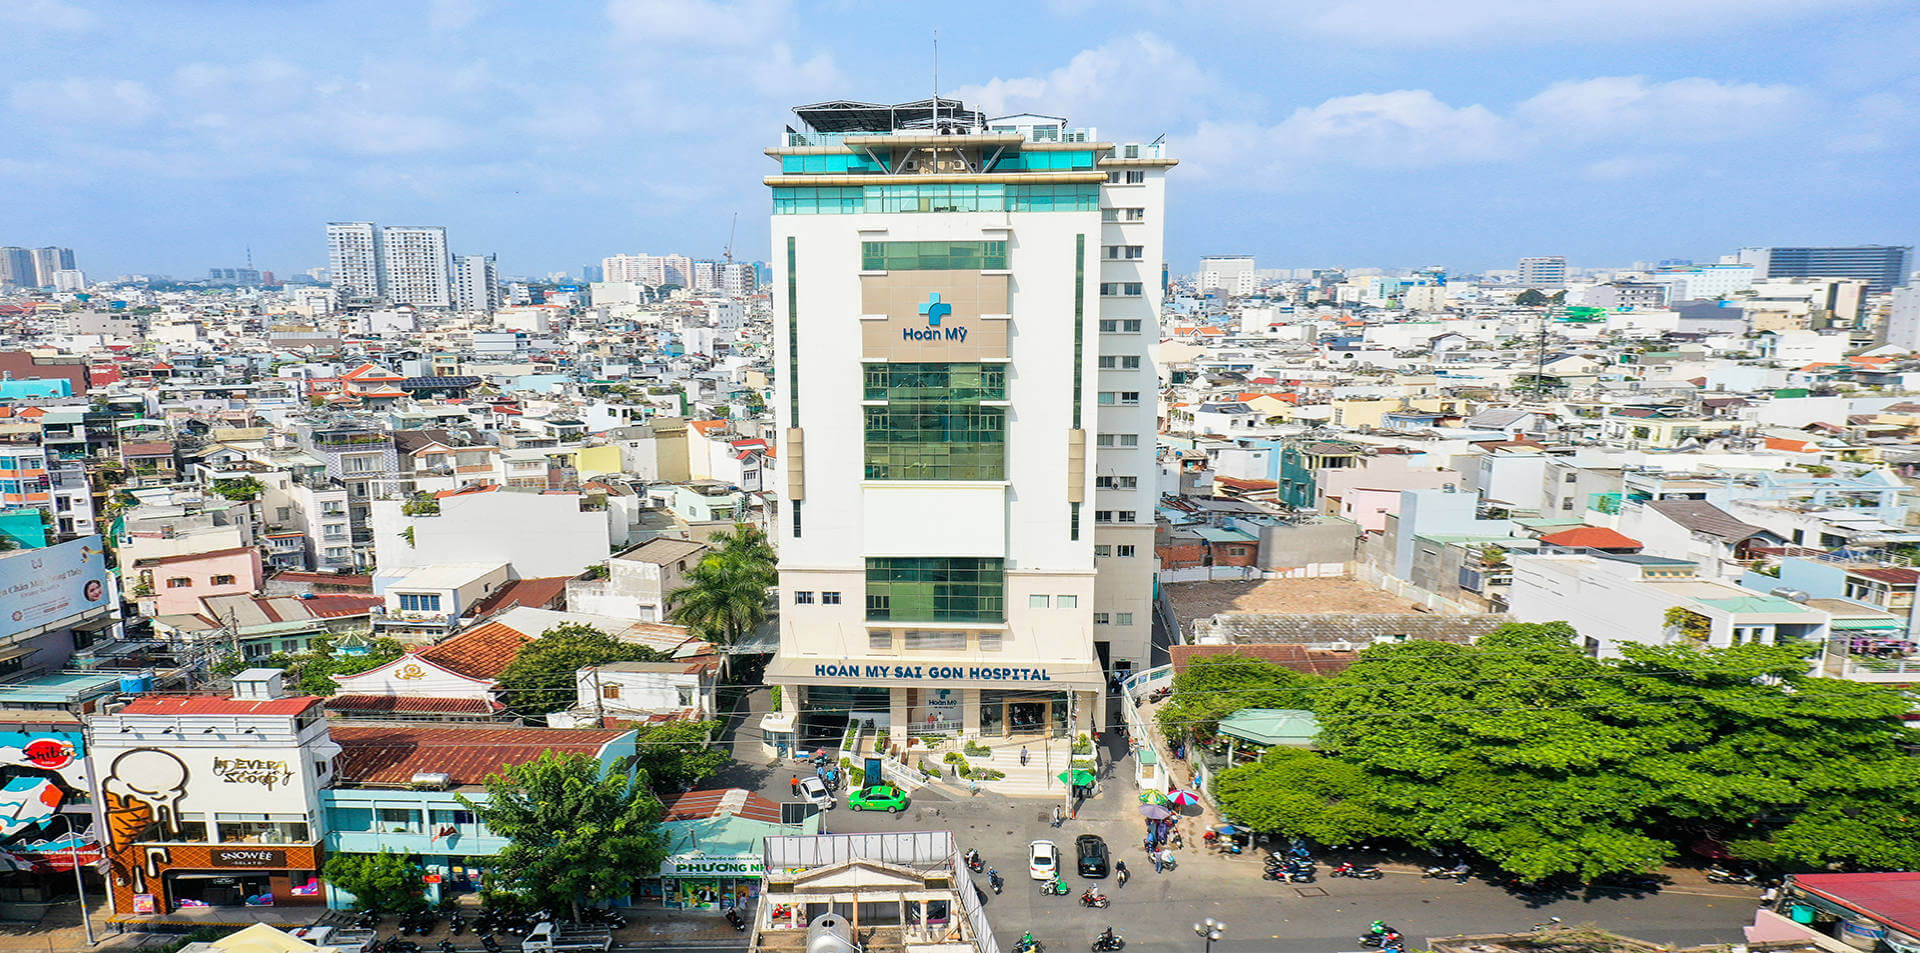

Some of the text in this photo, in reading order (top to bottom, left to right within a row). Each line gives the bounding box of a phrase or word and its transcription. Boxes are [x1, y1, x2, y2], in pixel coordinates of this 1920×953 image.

[903, 325, 967, 343] Hoàn Mỹ
[815, 664, 1051, 681] HOAN MY SAI GON HOSPITAL
[676, 862, 747, 872] PHƯƠNG
